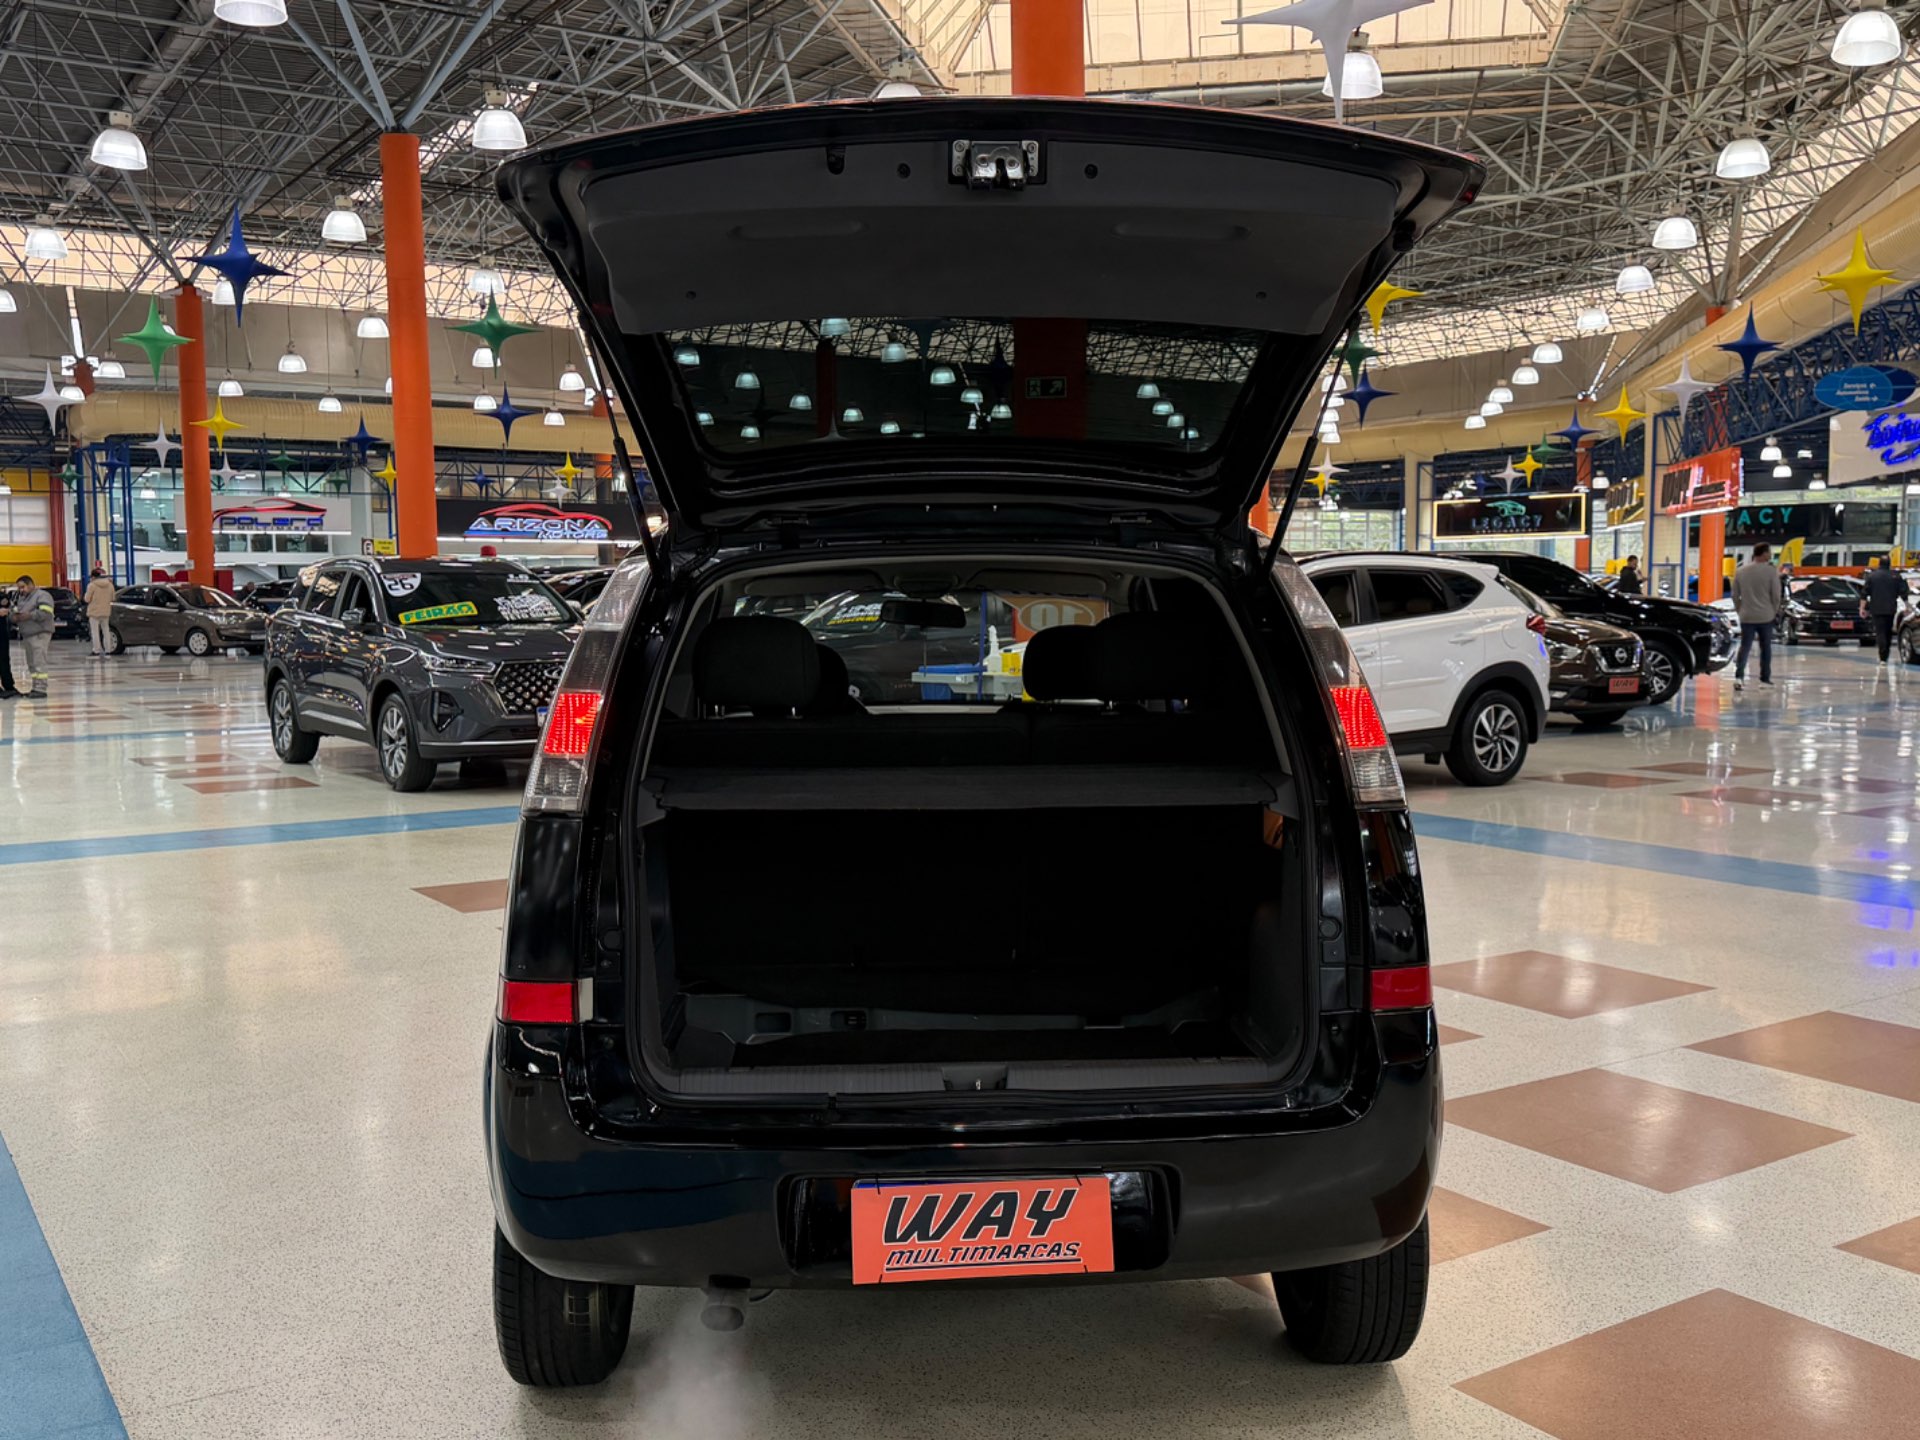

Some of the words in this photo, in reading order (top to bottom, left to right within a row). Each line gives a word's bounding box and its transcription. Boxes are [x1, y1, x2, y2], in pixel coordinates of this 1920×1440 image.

[468, 516, 608, 532] ARIZONA
[1471, 514, 1543, 529] LEGACY
[537, 530, 609, 540] MOTORS
[404, 602, 474, 622] FEIRÃO
[883, 1188, 1079, 1246] WAY
[885, 1241, 1082, 1267] MULTIMARCAS
